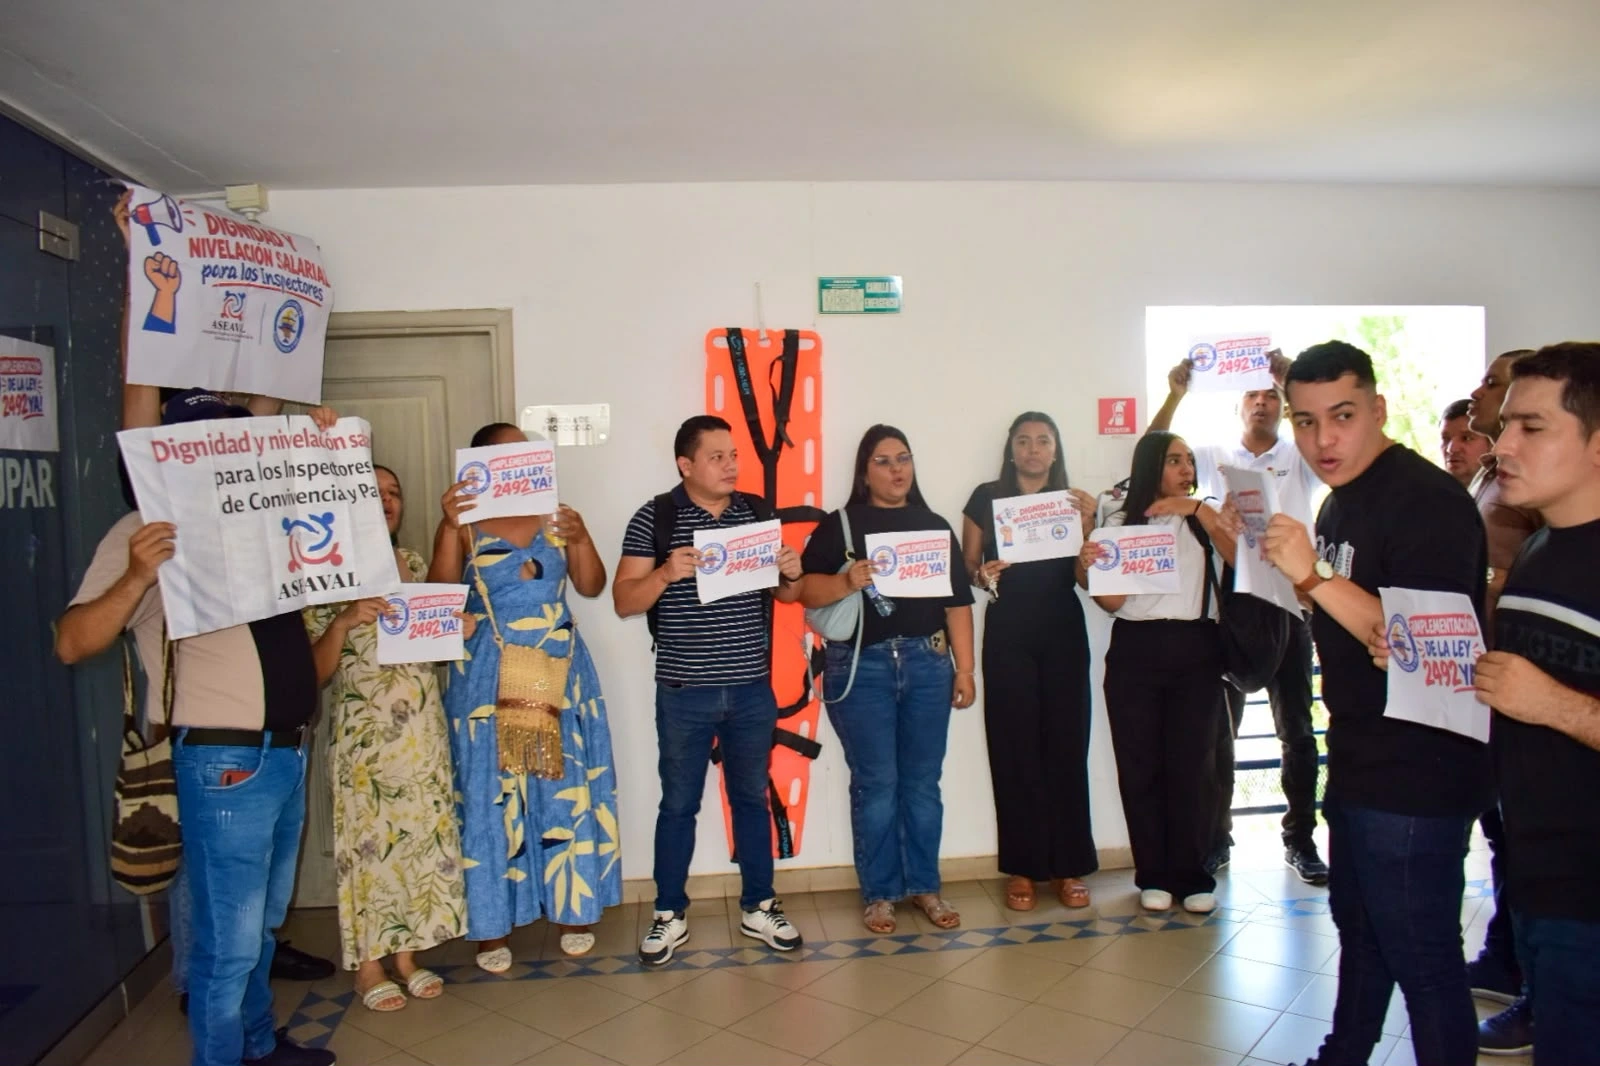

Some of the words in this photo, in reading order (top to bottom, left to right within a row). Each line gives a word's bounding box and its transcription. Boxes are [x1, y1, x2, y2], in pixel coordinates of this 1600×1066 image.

[203, 211, 285, 247] DIGNIDAD
[281, 232, 297, 251] Y
[189, 238, 274, 268] NIVELACIÓN
[276, 252, 331, 288] SALARIAL
[202, 263, 237, 284] para
[241, 262, 258, 281] los
[261, 267, 324, 301] Inspectores
[1217, 357, 1250, 375] 2492
[3, 394, 28, 417] 2492
[151, 430, 251, 465] Dignidad
[254, 436, 265, 456] y
[215, 467, 256, 490] para
[257, 460, 282, 481] los
[285, 459, 371, 482] Inspectores
[501, 469, 513, 482] DE
[514, 468, 527, 479] LA
[527, 466, 545, 478] LEY
[492, 478, 530, 498] 2492
[532, 476, 553, 490] YA!
[222, 495, 245, 514] de
[250, 484, 347, 510] Convivencia
[347, 488, 357, 505] y
[759, 544, 772, 554] LEY
[927, 551, 940, 561] LEY
[1152, 546, 1167, 557] LEY
[725, 556, 760, 576] 2492
[898, 562, 929, 580] 2492
[929, 561, 946, 573] YA!
[1121, 558, 1154, 575] 2492
[1155, 558, 1175, 570] YA!
[278, 571, 361, 600] ASEAVAL
[409, 619, 440, 640] 2492
[441, 618, 459, 633] YA!
[1424, 640, 1437, 657] DE
[1438, 640, 1451, 657] LA
[1453, 639, 1471, 657] LEY
[1422, 660, 1461, 686] 2492
